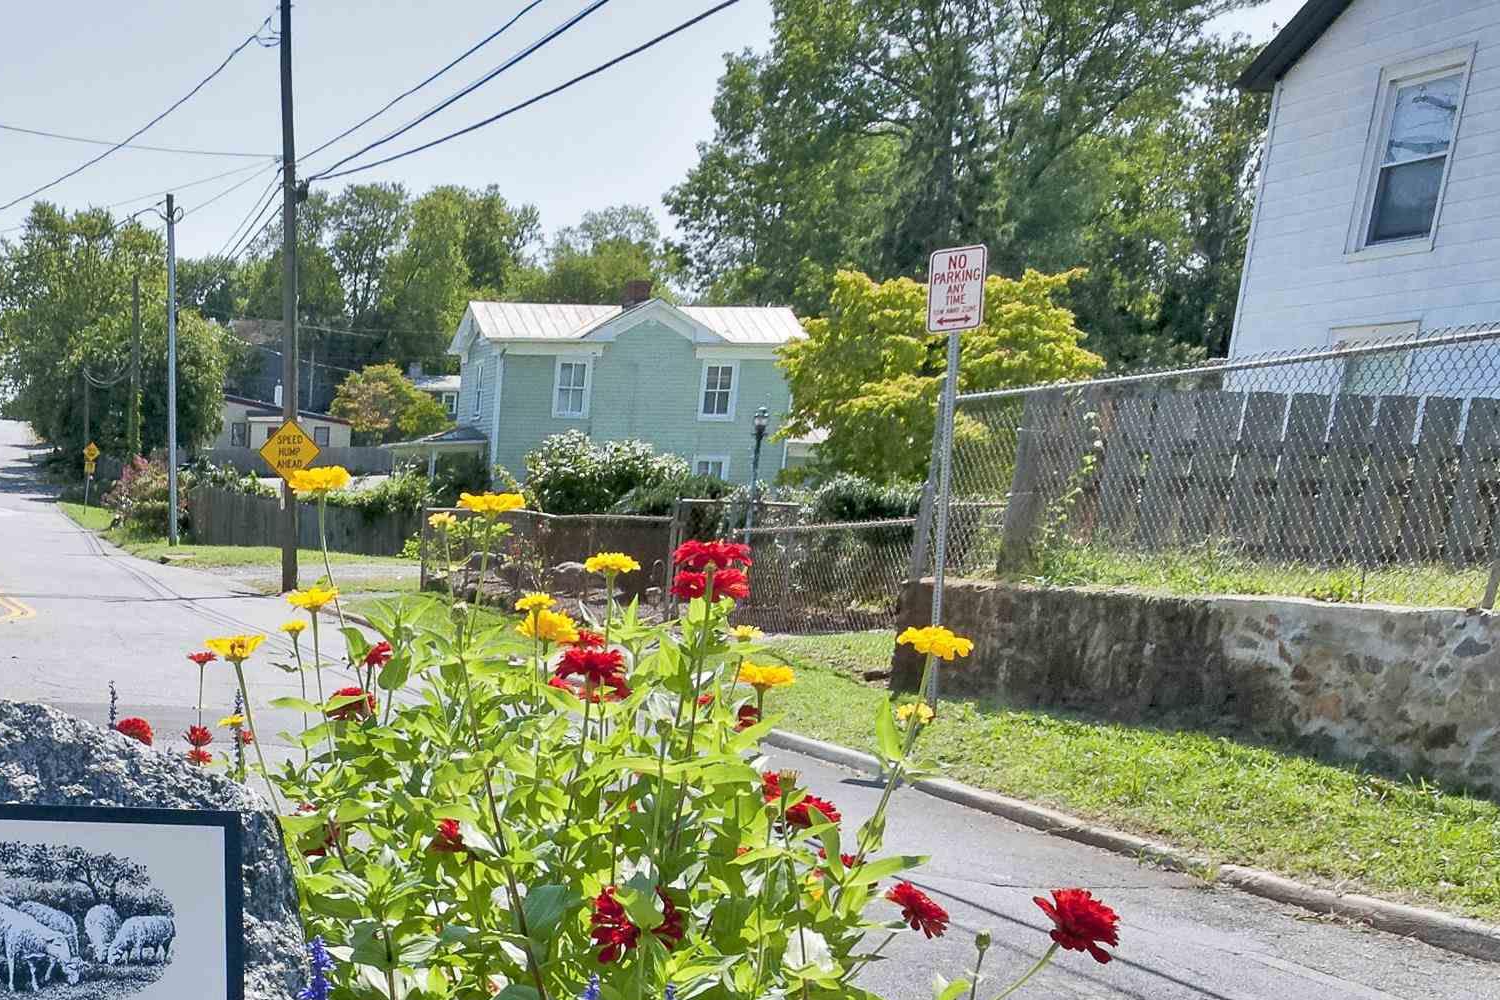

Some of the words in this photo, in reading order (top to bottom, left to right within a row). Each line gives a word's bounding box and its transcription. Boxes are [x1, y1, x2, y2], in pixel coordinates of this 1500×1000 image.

[948, 254, 967, 269] NO
[934, 268, 980, 285] PARKING
[947, 283, 965, 294] ANY
[946, 294, 966, 305] TIME
[276, 434, 303, 445] SPEED
[278, 447, 300, 457] HUMP
[276, 459, 302, 469] AHEAD
